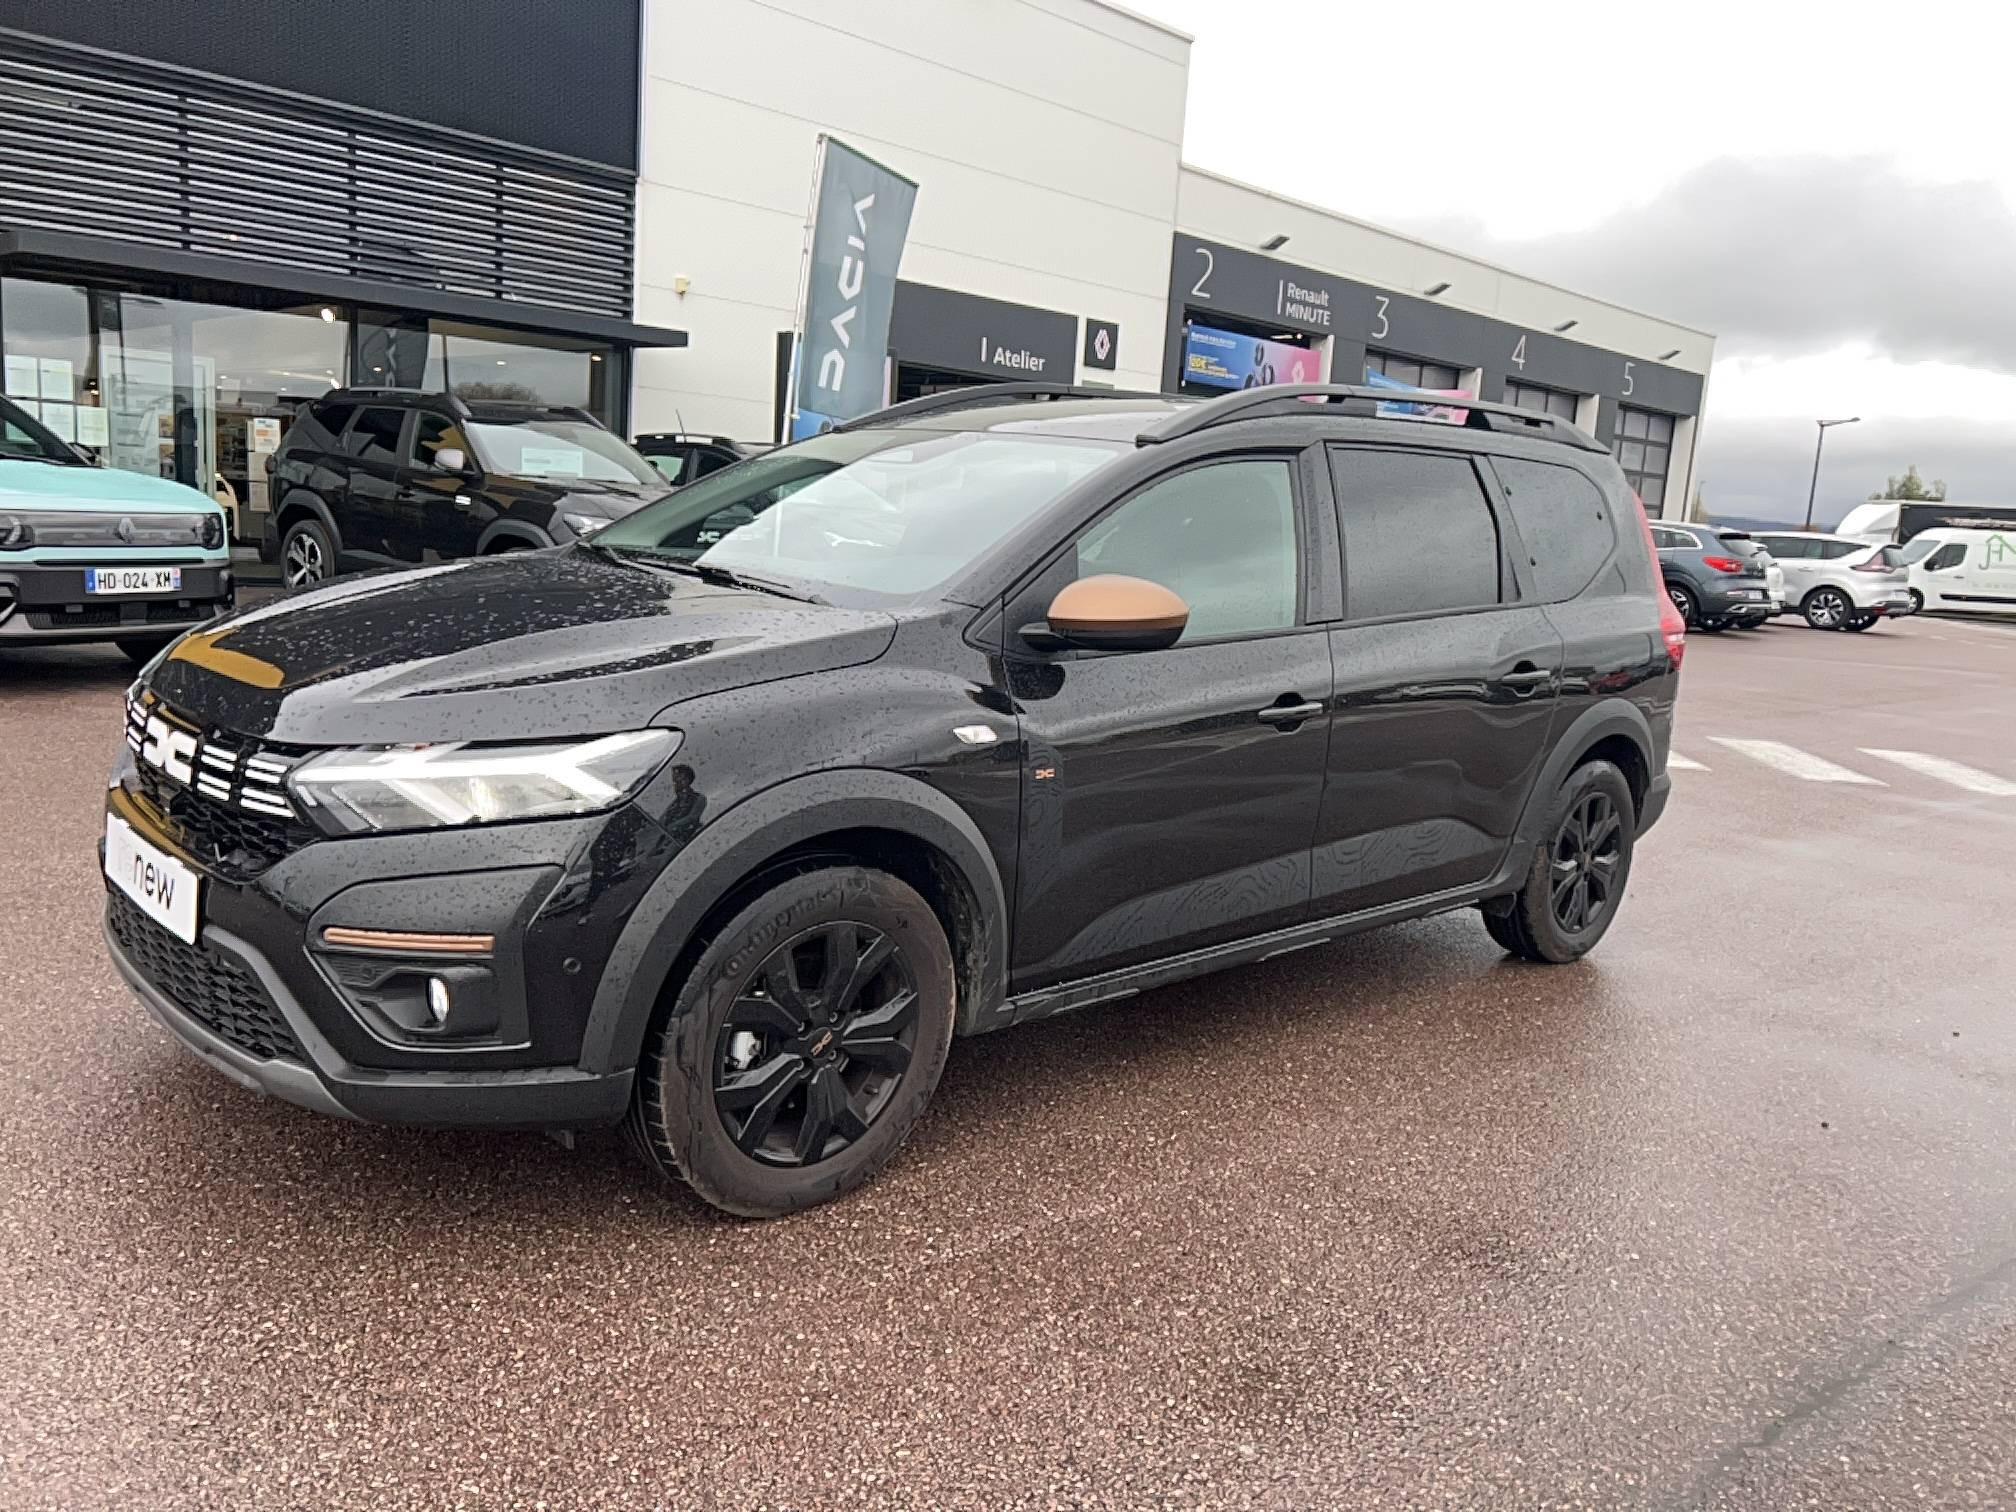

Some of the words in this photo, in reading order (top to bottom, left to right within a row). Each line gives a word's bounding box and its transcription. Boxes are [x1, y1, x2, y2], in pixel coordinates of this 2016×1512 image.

[1191, 248, 1214, 298] 2
[818, 193, 875, 391] DACIA
[1287, 282, 1329, 307] Renault
[1285, 302, 1331, 326] MINUTE
[1371, 295, 1390, 339] 3
[993, 347, 1046, 371] Atelier
[1511, 335, 1526, 371] 4
[1622, 361, 1636, 395] 5
